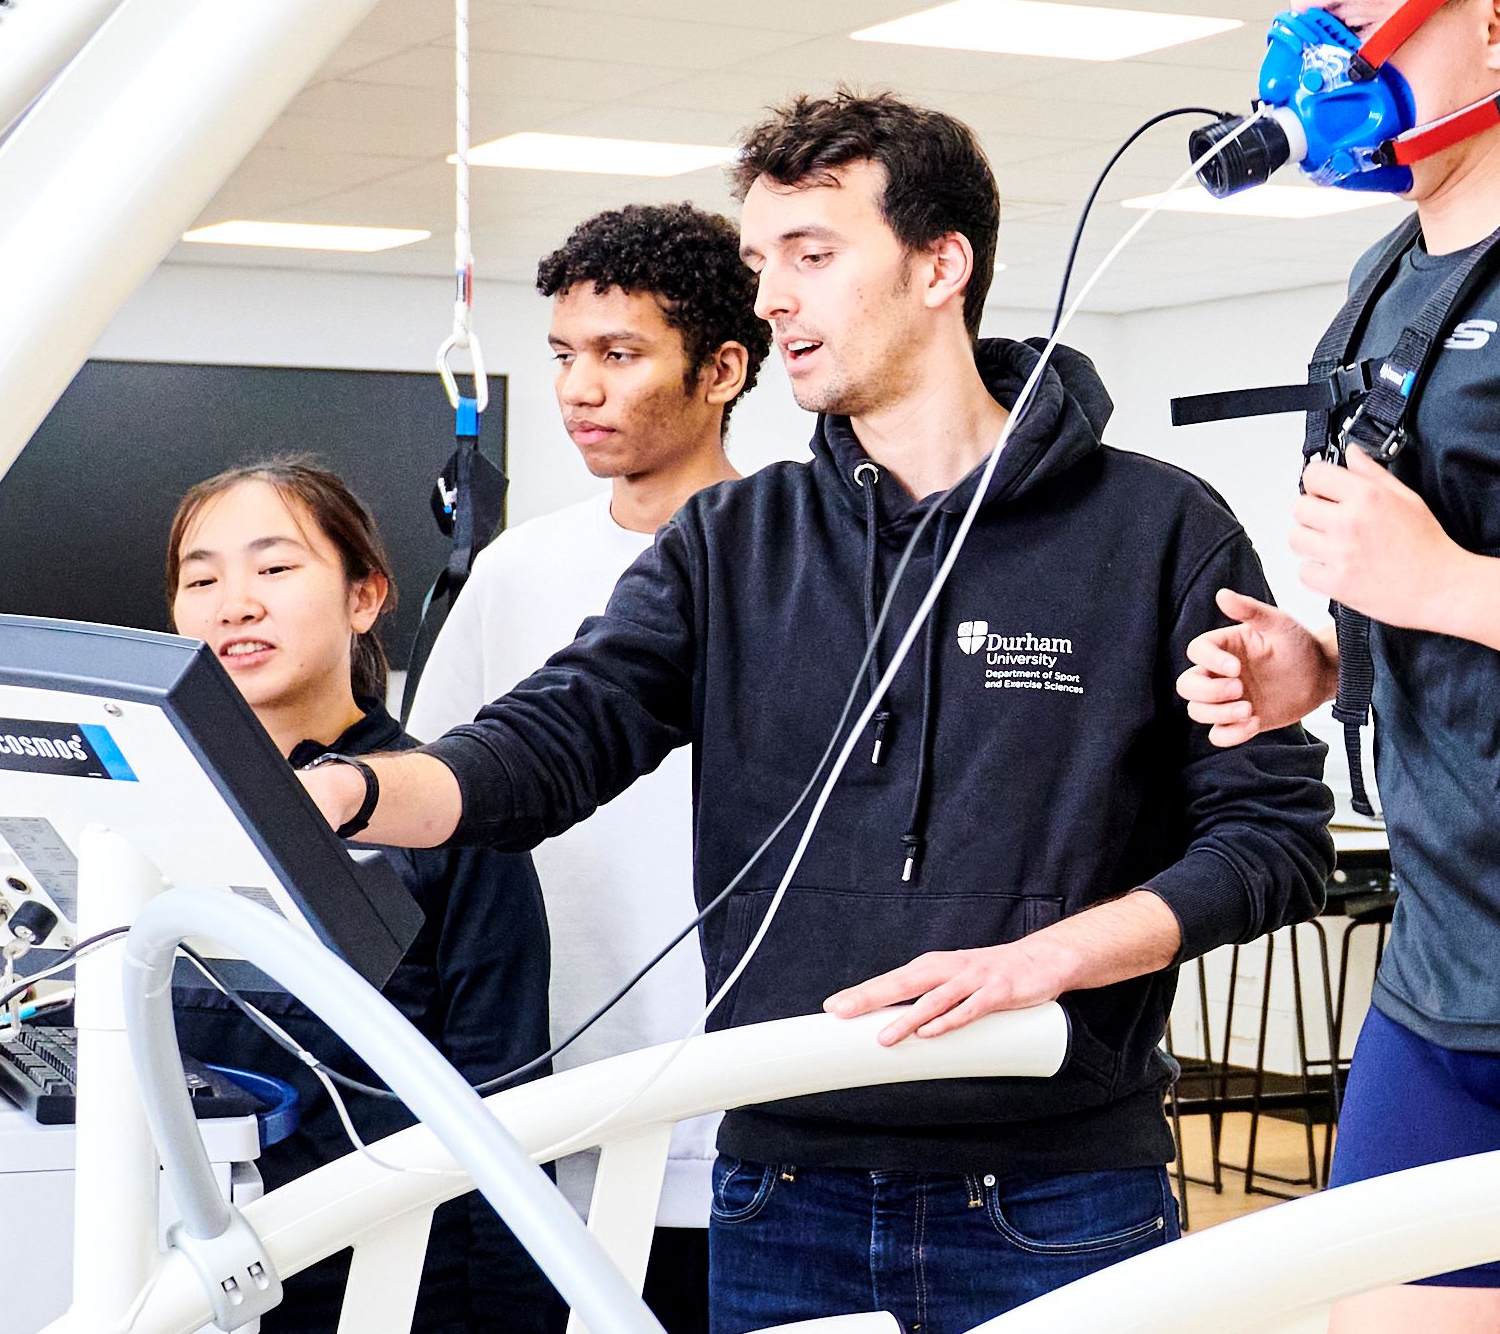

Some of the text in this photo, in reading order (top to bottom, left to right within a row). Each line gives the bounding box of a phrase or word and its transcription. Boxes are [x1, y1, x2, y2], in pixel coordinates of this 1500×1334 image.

[986, 632, 1073, 654] Durham
[986, 652, 1057, 668] University
[985, 669, 1080, 682] Department of Sport
[984, 680, 1084, 694] and Exercise Sciences
